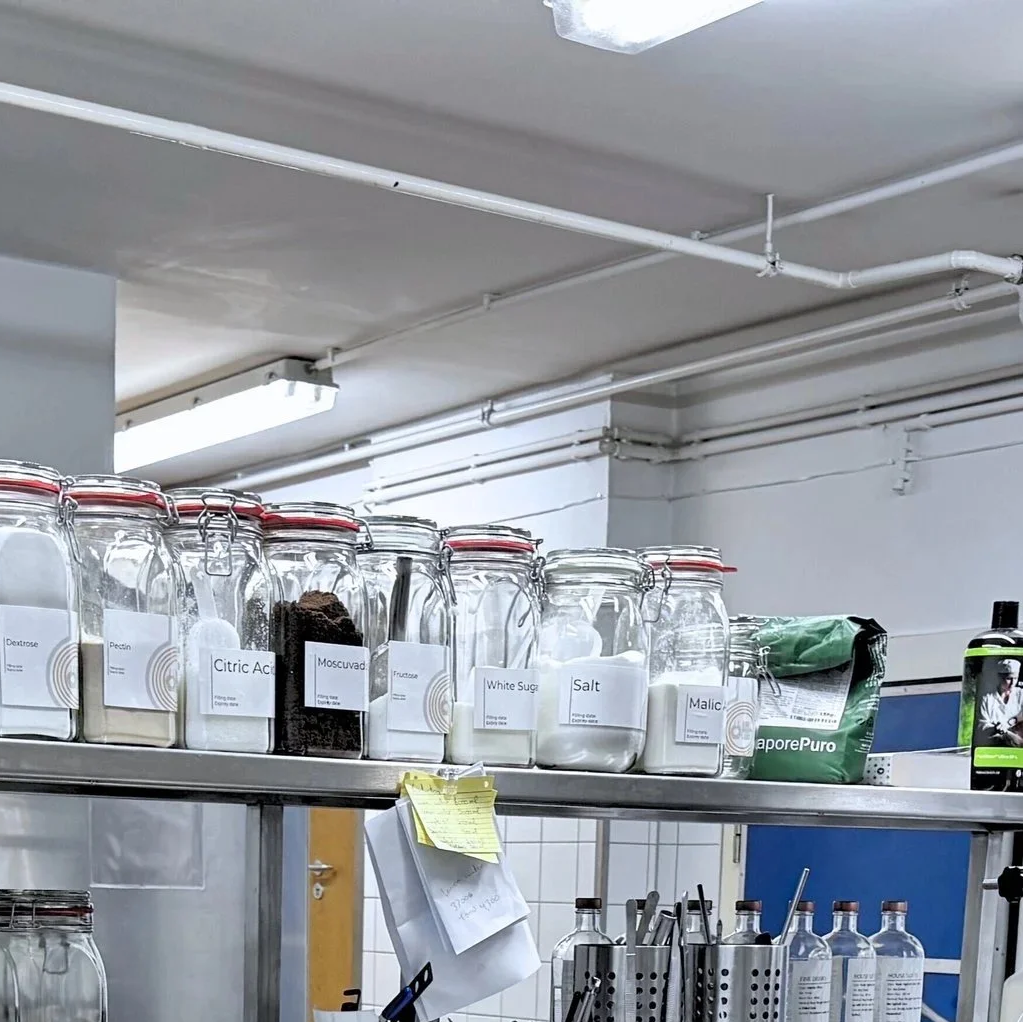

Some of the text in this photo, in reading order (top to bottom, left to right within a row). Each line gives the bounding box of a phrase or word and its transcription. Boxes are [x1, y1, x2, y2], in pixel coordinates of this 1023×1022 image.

[6, 638, 39, 648] Dextrose
[109, 641, 132, 651] Pectin
[214, 658, 249, 674] Citric
[317, 657, 367, 671] Moscuvad
[393, 670, 419, 680] Fructose
[486, 679, 516, 691] White
[573, 678, 601, 692] Salt
[689, 697, 722, 711] Malic
